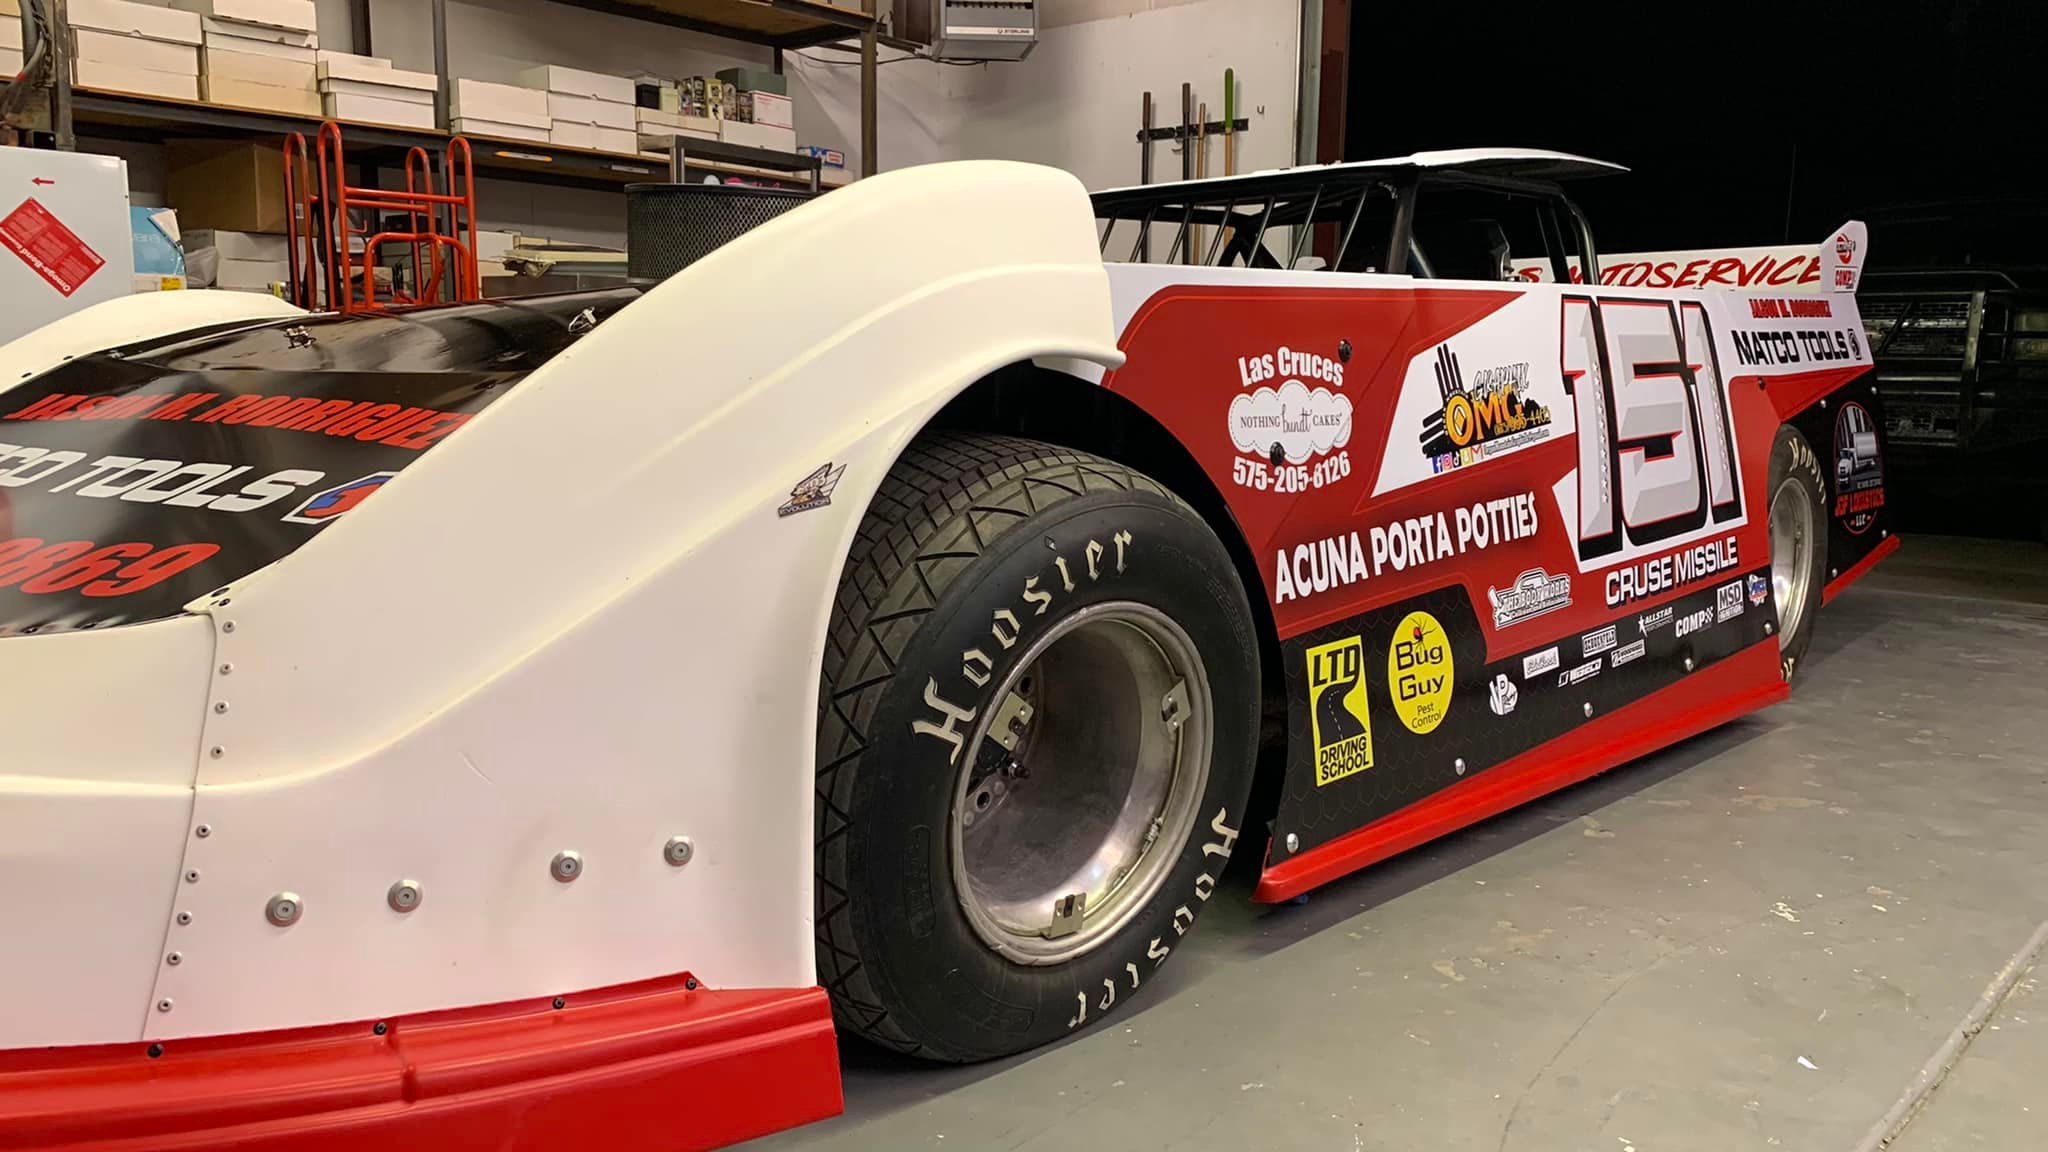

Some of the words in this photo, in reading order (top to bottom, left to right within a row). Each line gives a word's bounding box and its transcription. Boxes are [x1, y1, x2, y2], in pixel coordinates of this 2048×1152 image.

[1569, 254, 1820, 289] TOSERVICE
[1731, 330, 1800, 365] MATCO
[1796, 330, 1849, 362] TOOLS
[1238, 354, 1275, 387] Las
[1277, 346, 1344, 387] Cruces
[2, 393, 176, 420] JASON
[190, 394, 475, 449] RODRIGUEZ
[1240, 415, 1280, 428] NOTHING
[1446, 384, 1523, 446] OMG
[1560, 294, 1742, 561] 151
[48, 456, 325, 511] TOOLS
[1232, 451, 1351, 493] 575-205-8126
[1275, 531, 1369, 604] ACUNA
[1370, 511, 1454, 576] PORTA
[1455, 491, 1538, 553] POTTIES
[1605, 556, 1673, 606] CRUSE
[1674, 536, 1738, 584] MISSILE
[1720, 583, 1741, 609] MSD
[1645, 606, 1673, 624] ALLSTAR
[1675, 609, 1706, 638] COMP
[1312, 643, 1361, 687] LTD
[1396, 640, 1444, 671] Bug
[1399, 674, 1445, 701] Guy
[1411, 710, 1442, 728] Control
[1417, 702, 1434, 716] Pest
[1320, 735, 1367, 766] DRIVING
[1321, 751, 1370, 781] SCHOOL
